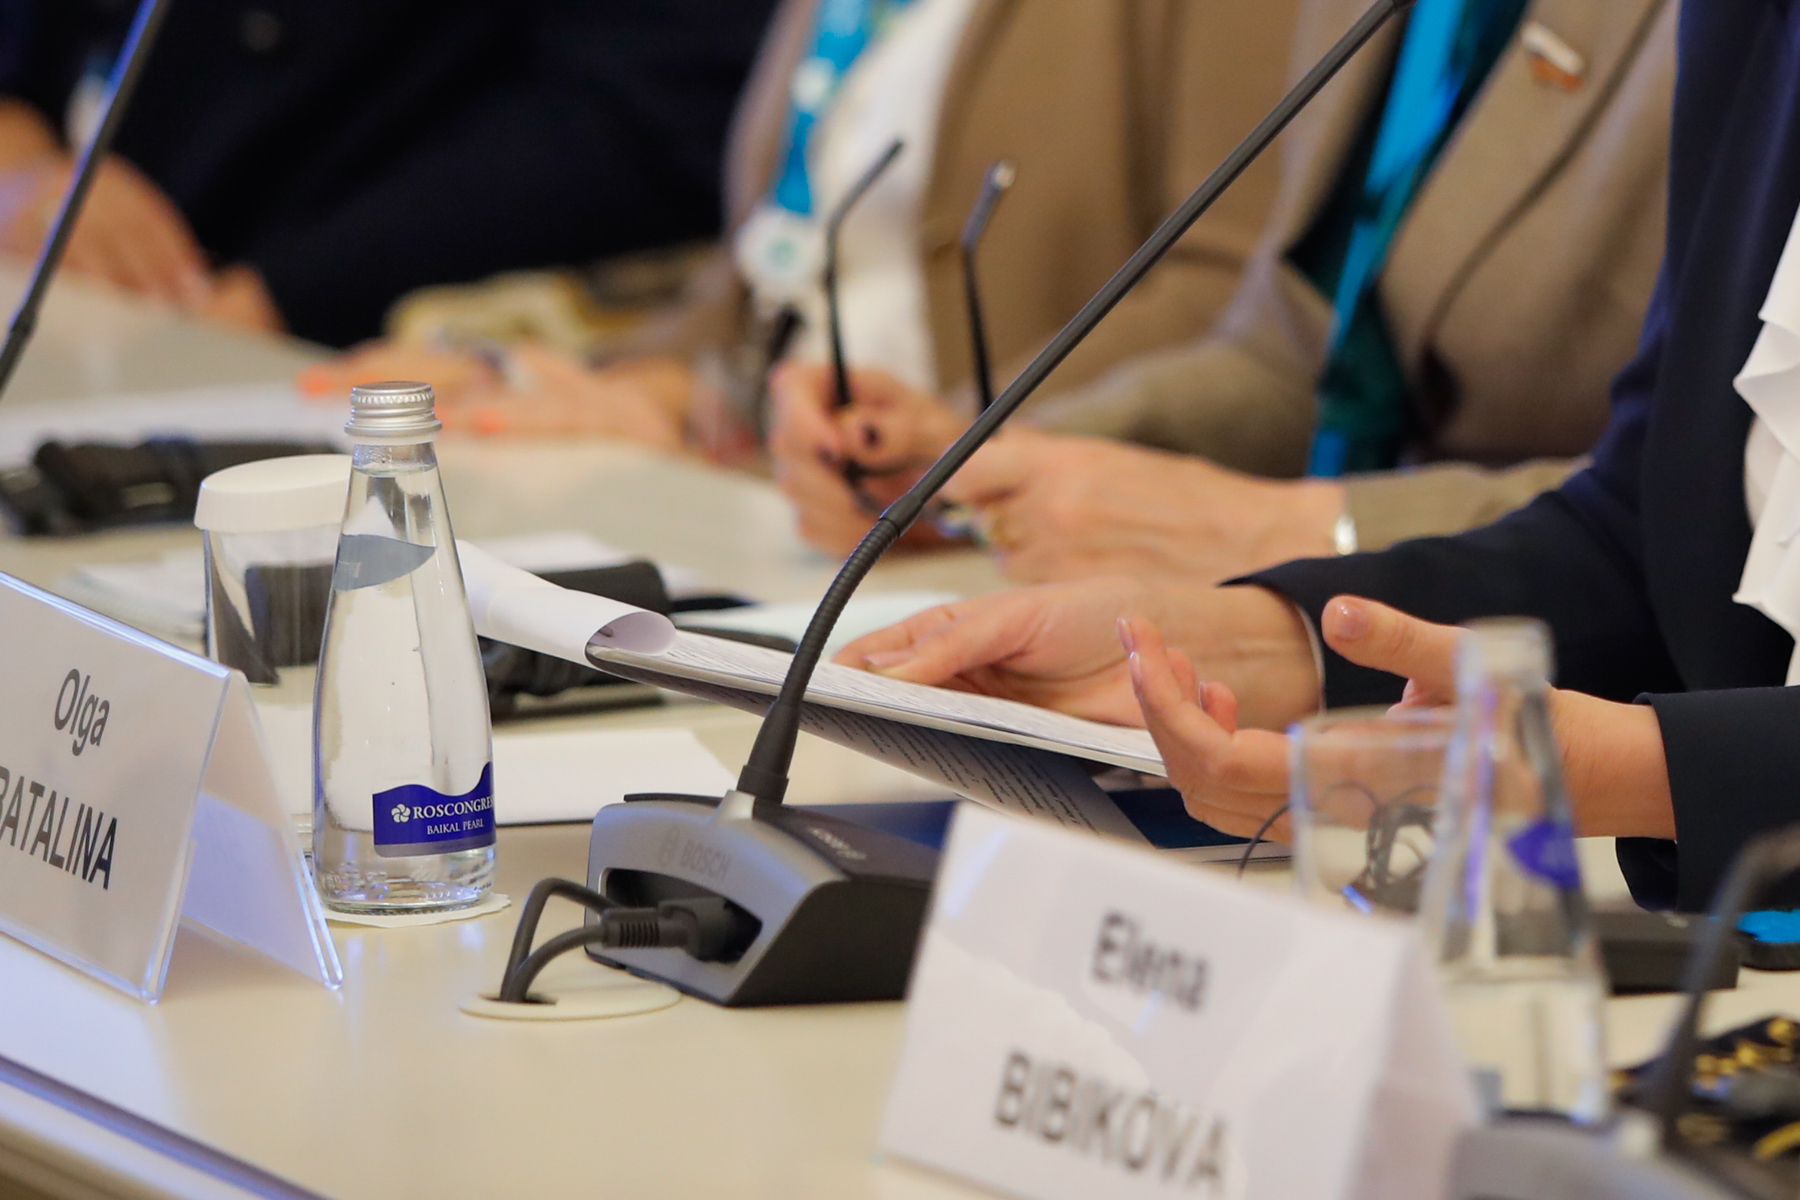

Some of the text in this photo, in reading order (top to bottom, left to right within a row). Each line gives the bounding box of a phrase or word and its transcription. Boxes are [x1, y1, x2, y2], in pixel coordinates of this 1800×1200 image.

[54, 668, 110, 756] Olga
[412, 795, 494, 820] ROSCONGRE
[426, 818, 485, 835] BAIKAL PEARL
[679, 838, 733, 881] BOSCH
[1090, 908, 1213, 1009] Elena
[991, 1048, 1230, 1195] BIBIKOVA
